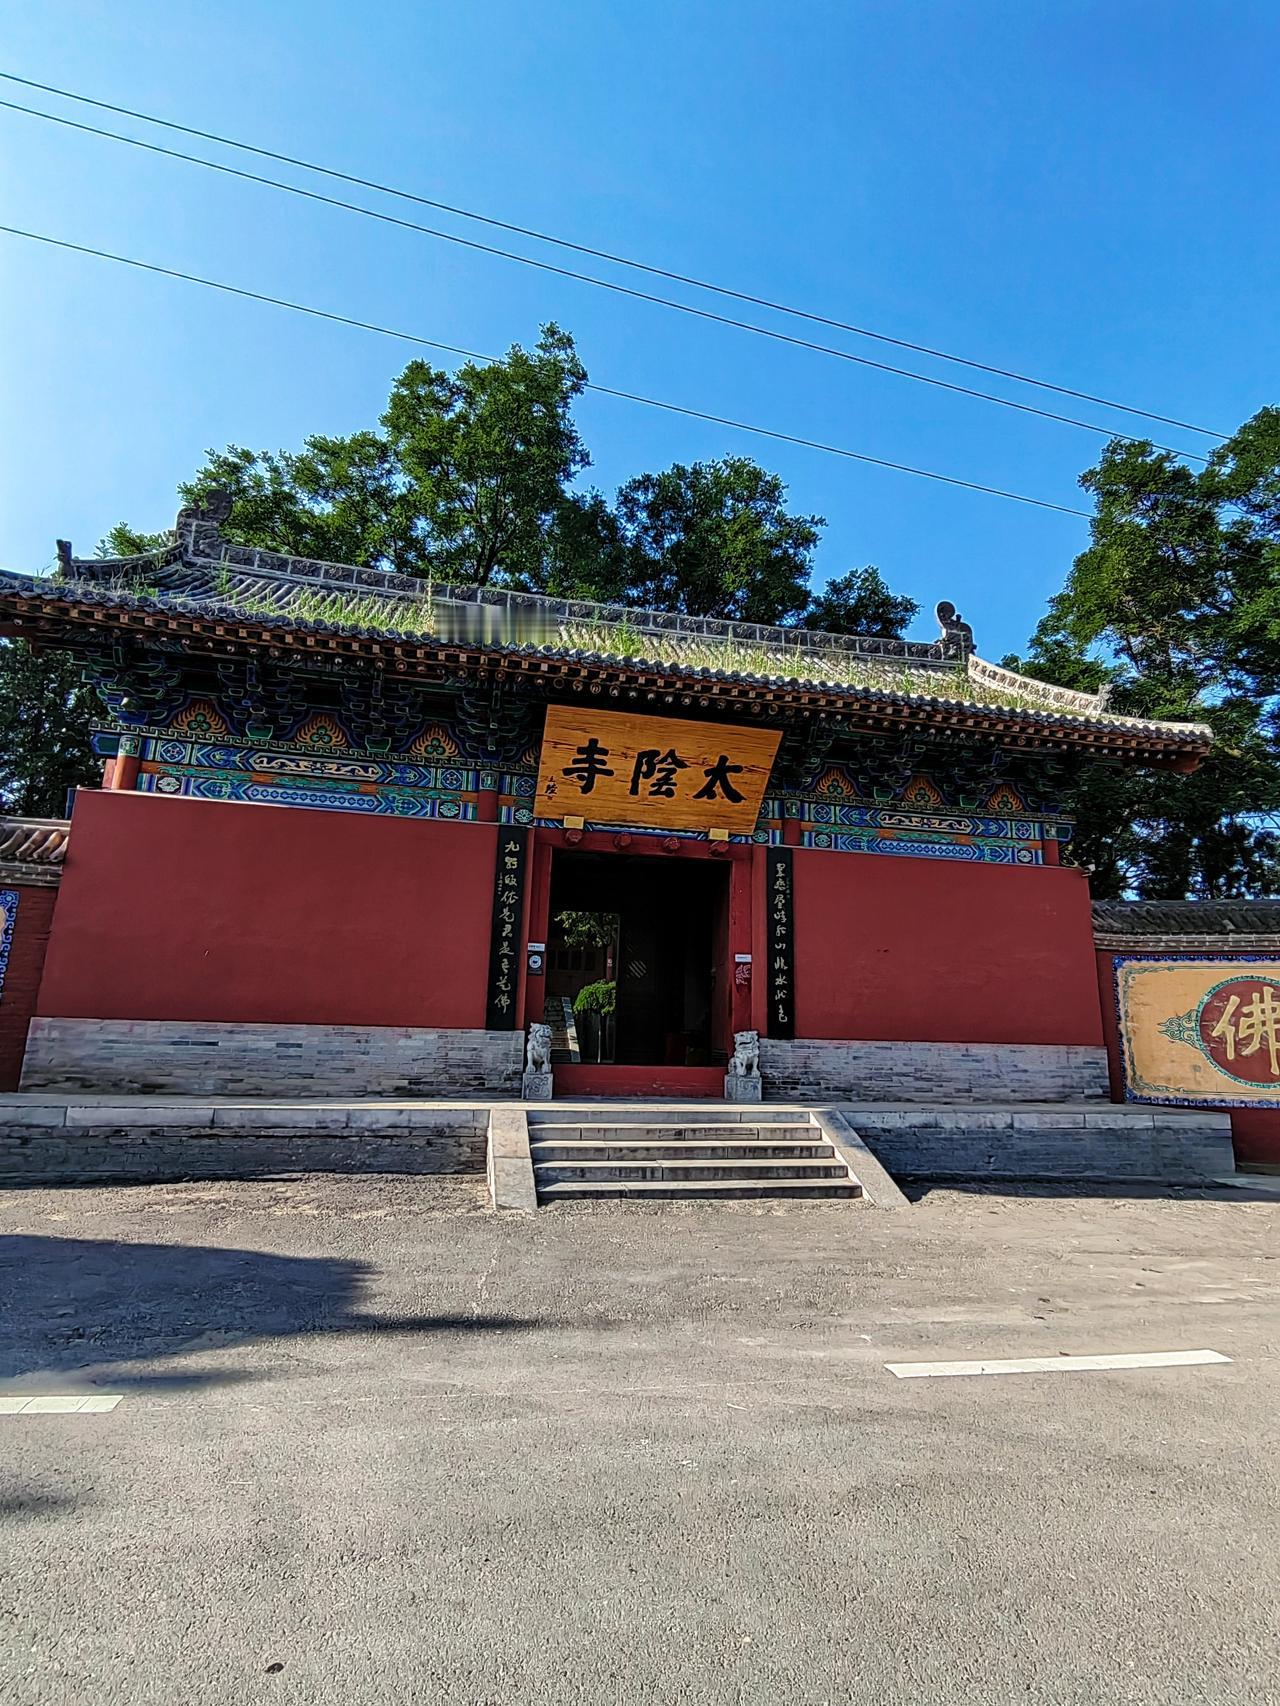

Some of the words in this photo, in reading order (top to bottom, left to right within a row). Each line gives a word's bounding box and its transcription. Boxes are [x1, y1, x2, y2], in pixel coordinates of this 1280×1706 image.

[562, 738, 747, 804] 太陰寺
[1211, 986, 1280, 1076] 佛
